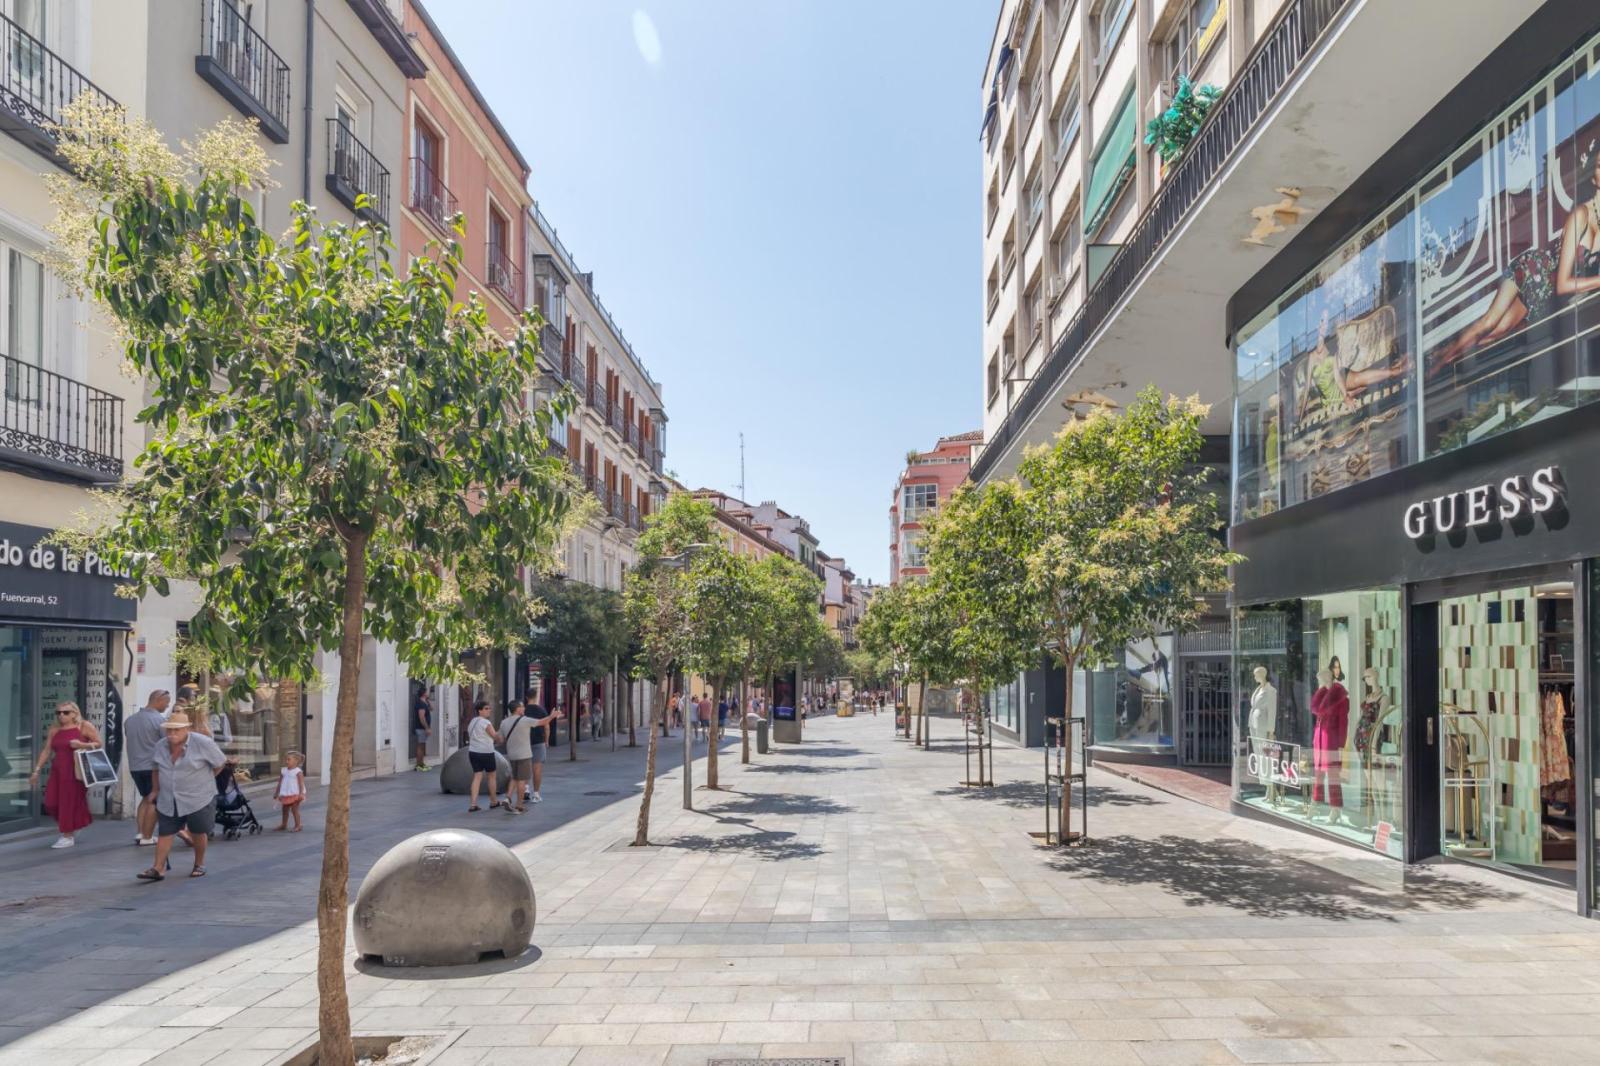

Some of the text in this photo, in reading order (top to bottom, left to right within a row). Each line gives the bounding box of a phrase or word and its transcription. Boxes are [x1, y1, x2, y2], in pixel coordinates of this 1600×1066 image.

[1404, 466, 1557, 539] GUESS
[29, 545, 56, 570] de
[62, 547, 79, 573] la
[1, 592, 58, 605] Fuencarral, 52
[1249, 752, 1298, 785] GUESS
